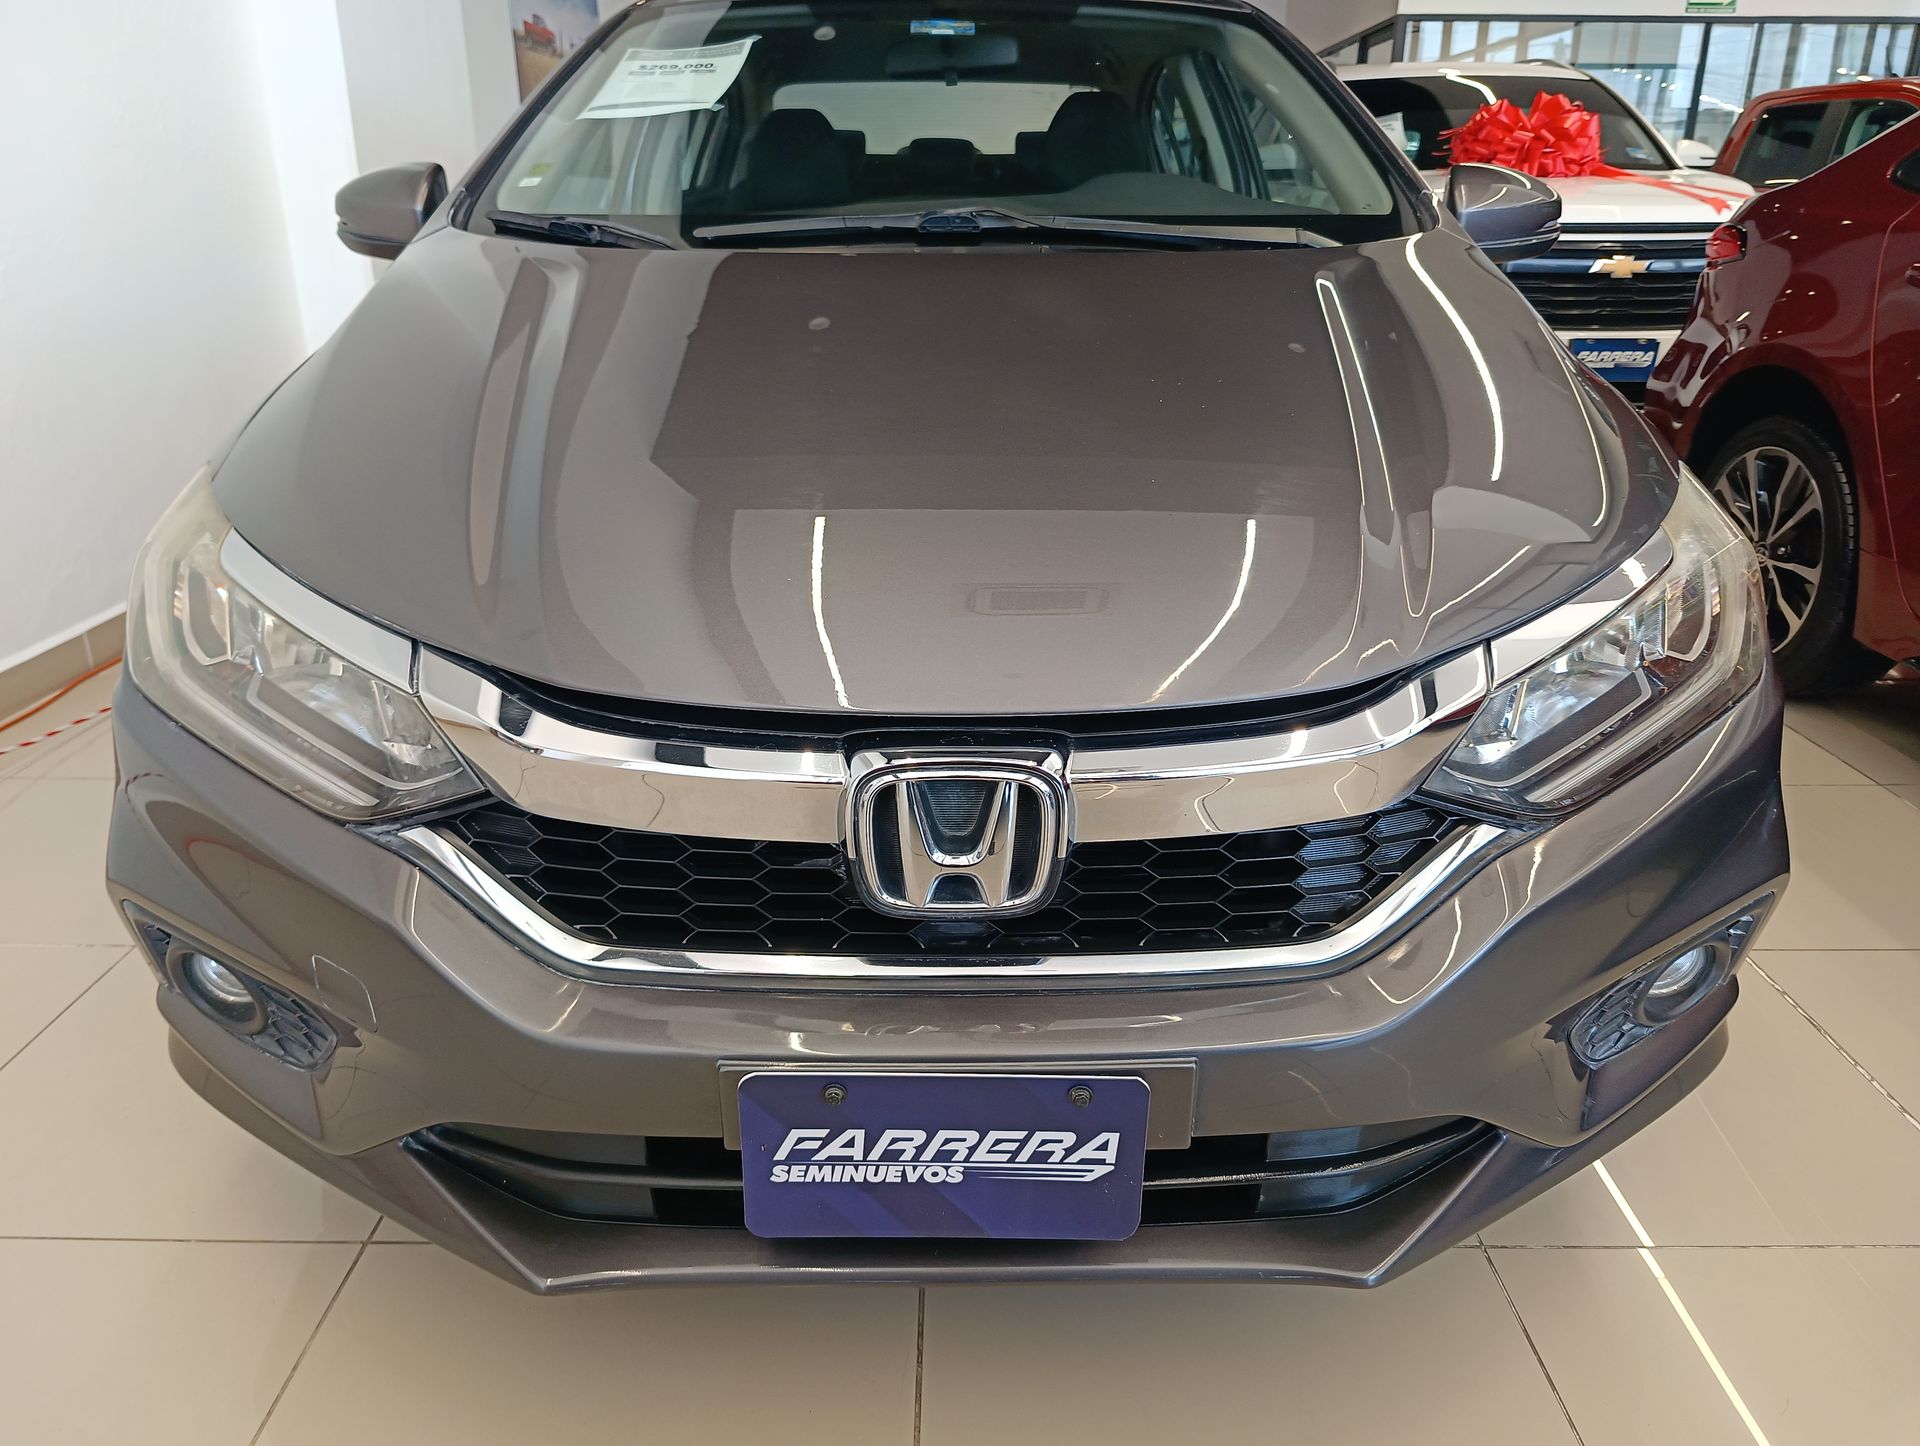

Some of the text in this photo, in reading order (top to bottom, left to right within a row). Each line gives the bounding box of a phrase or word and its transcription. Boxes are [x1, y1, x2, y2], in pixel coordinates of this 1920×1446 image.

[1576, 351, 1655, 362] FARRERA
[772, 1128, 1121, 1164] FARRERA
[769, 1164, 965, 1184] SEMINUEVOS
